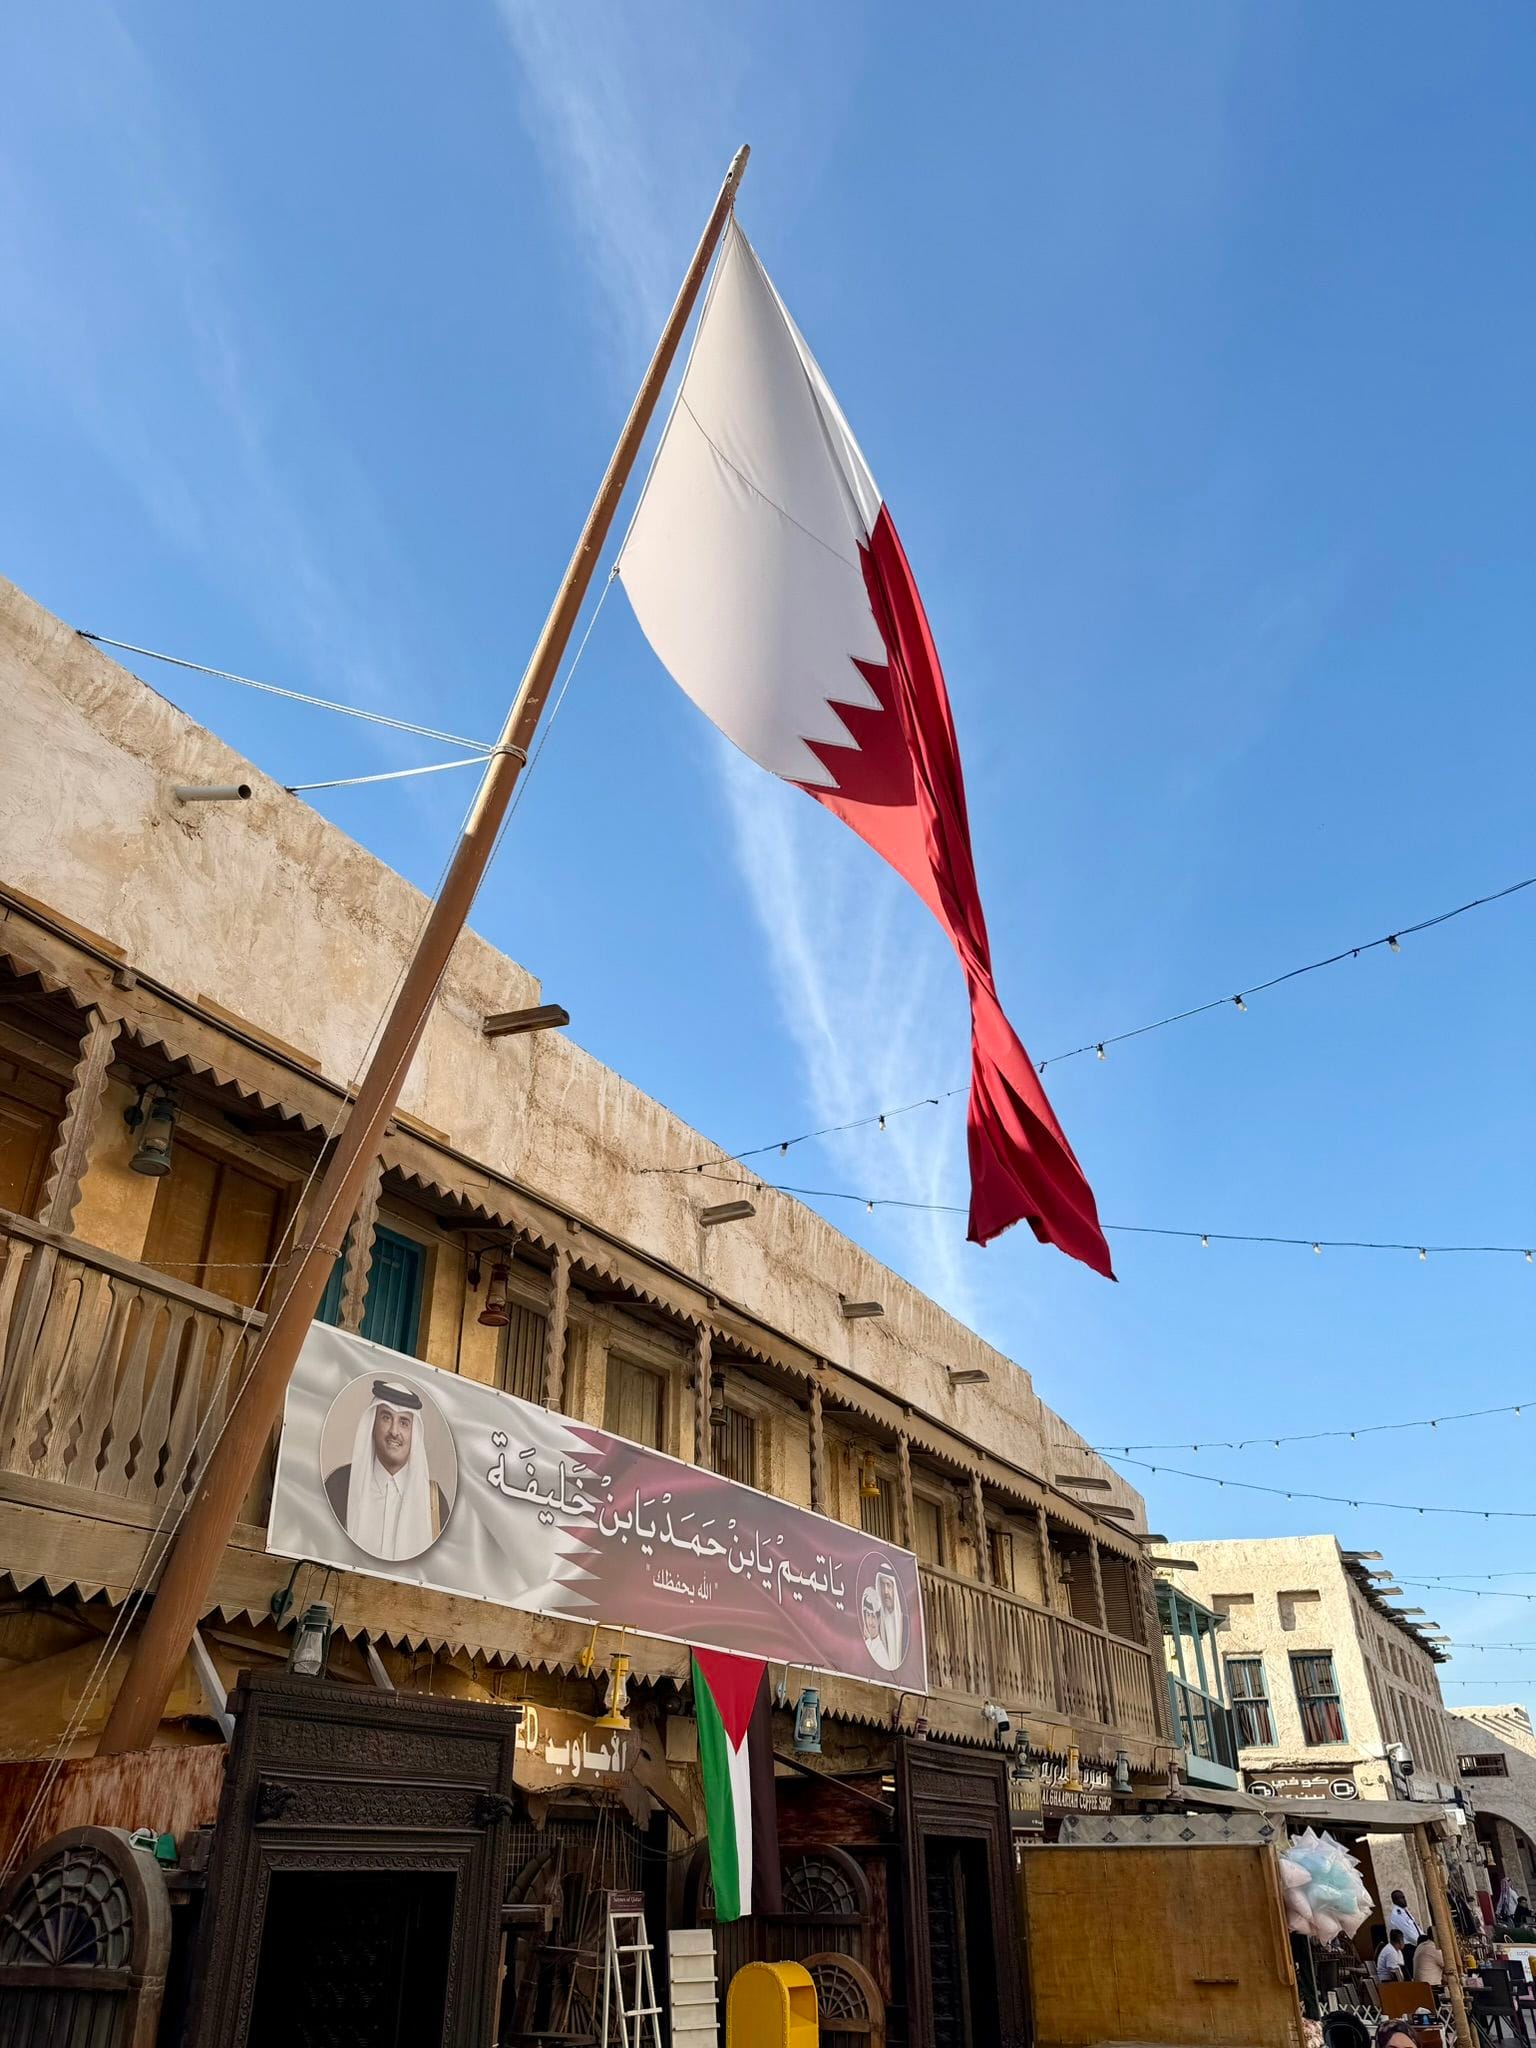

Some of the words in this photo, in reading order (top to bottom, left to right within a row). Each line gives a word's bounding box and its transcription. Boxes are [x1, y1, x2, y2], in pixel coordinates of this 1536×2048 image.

[545, 1730, 627, 1778] الأجاويد
[1080, 1793, 1098, 1811] COFFEE
[1099, 1796, 1112, 1812] SHOP
